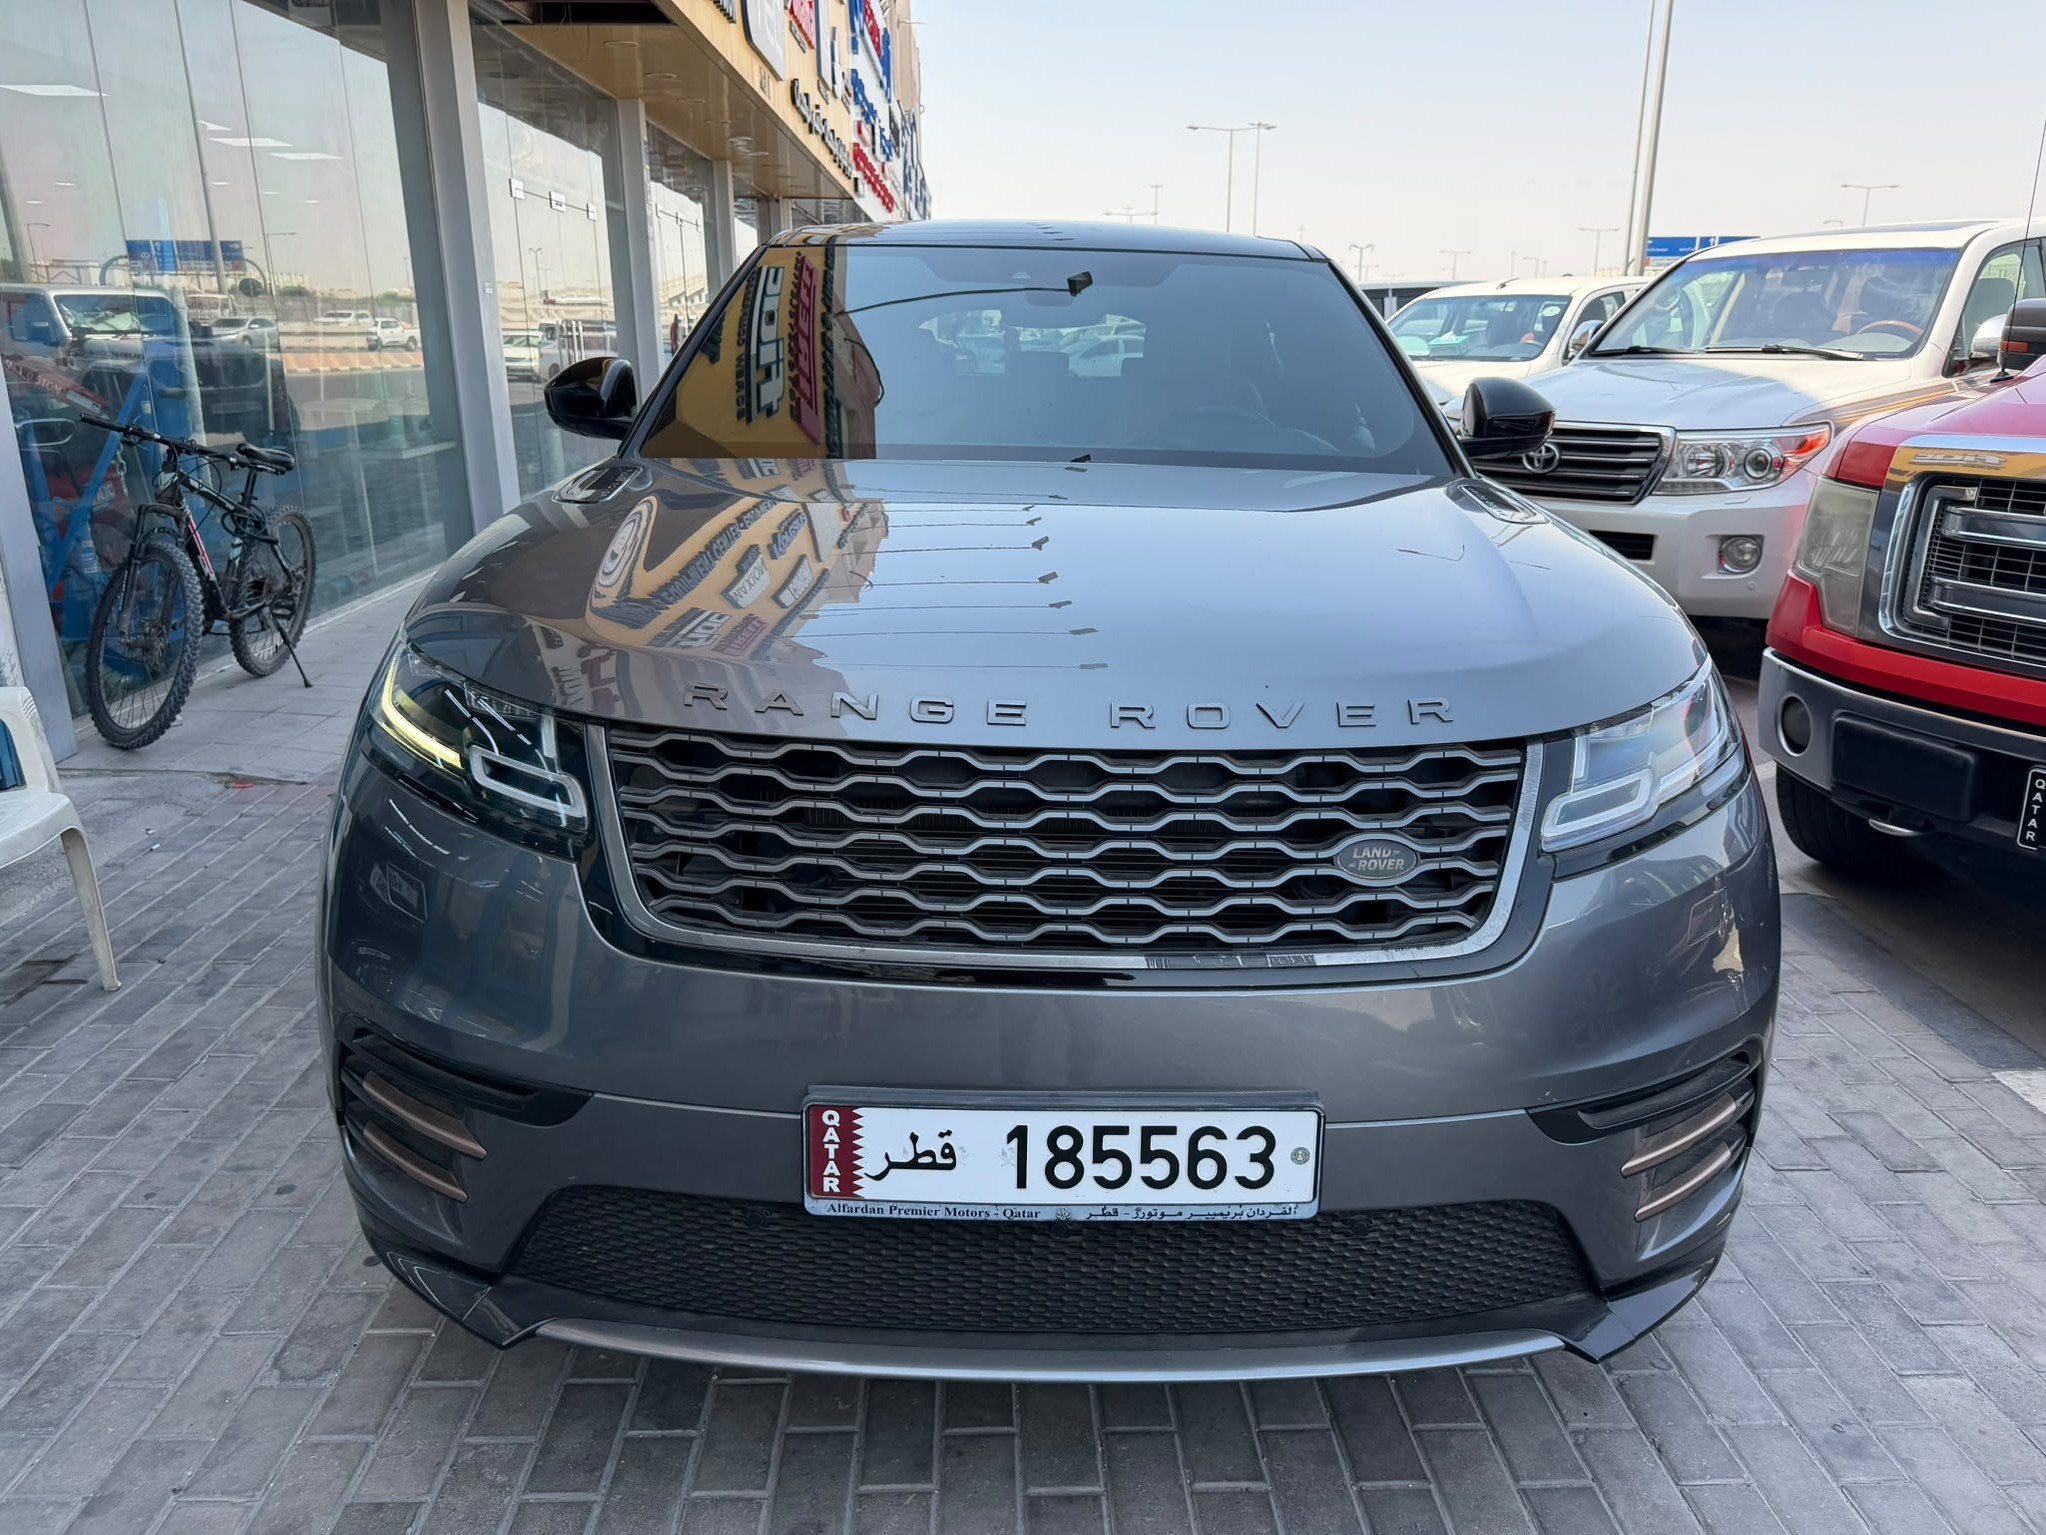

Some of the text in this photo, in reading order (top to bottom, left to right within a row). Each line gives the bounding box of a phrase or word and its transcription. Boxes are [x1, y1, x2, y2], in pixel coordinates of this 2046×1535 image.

[684, 681, 1454, 729] RANGE ROVER
[2025, 778, 2046, 842] QATAR
[1352, 847, 1404, 871] LAND ROVER
[822, 1110, 841, 1193] QATAR
[864, 1129, 958, 1181] قطر
[1006, 1125, 1277, 1190] 185563
[827, 1203, 884, 1216] Alfardan
[889, 1205, 940, 1217] Premier
[944, 1206, 990, 1218] Motors
[1003, 1207, 1041, 1220] Qatar
